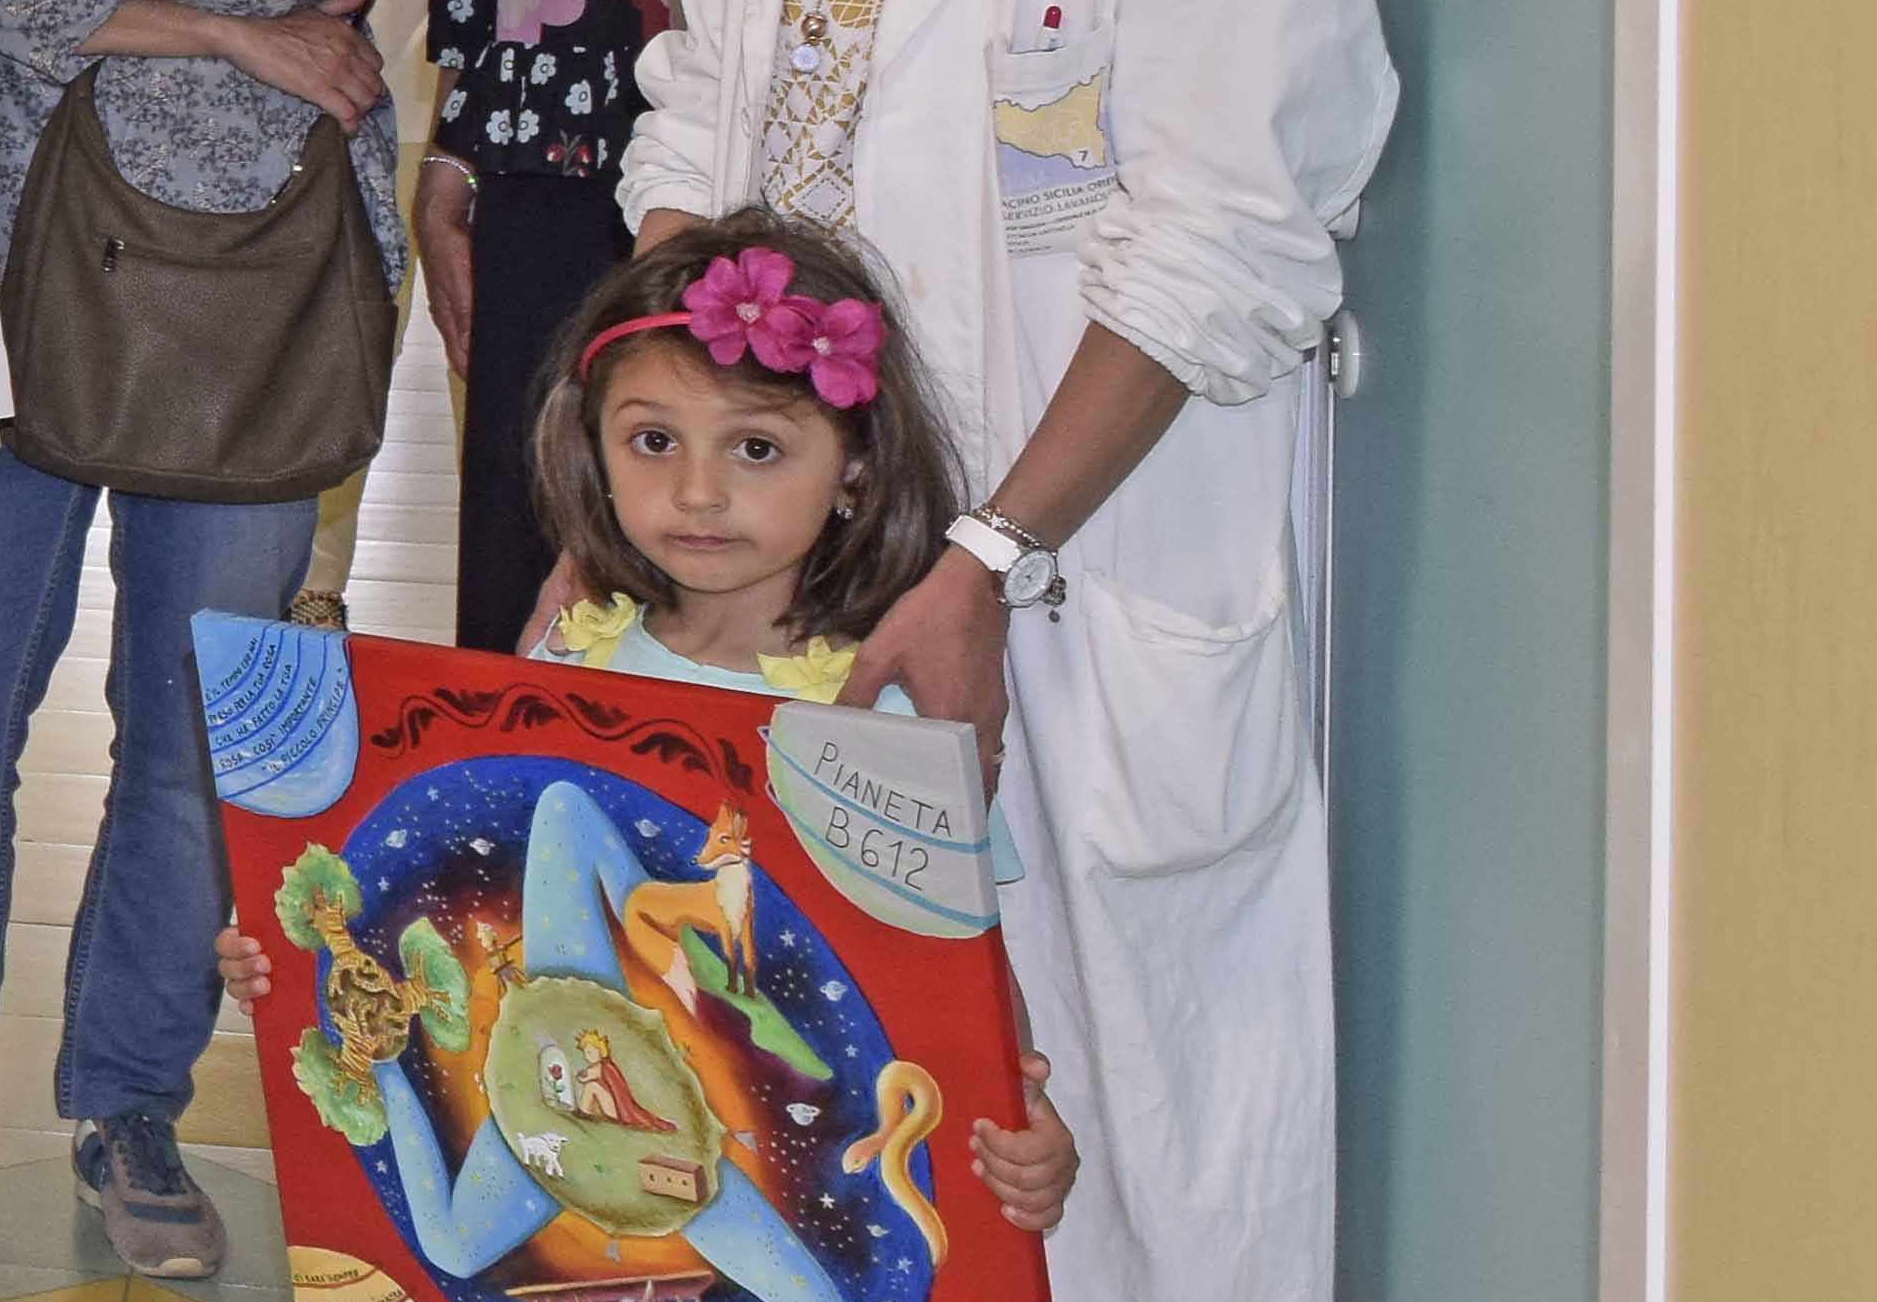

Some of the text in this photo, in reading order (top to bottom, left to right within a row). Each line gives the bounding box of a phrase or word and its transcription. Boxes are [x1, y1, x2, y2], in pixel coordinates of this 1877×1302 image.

[1078, 149, 1089, 162] 7
[1043, 186, 1083, 201] SICILIA
[251, 701, 276, 727] FATTO
[277, 674, 318, 735] IMPORTANTE
[282, 728, 318, 766] PICCOLO
[813, 741, 953, 838] PIANETA
